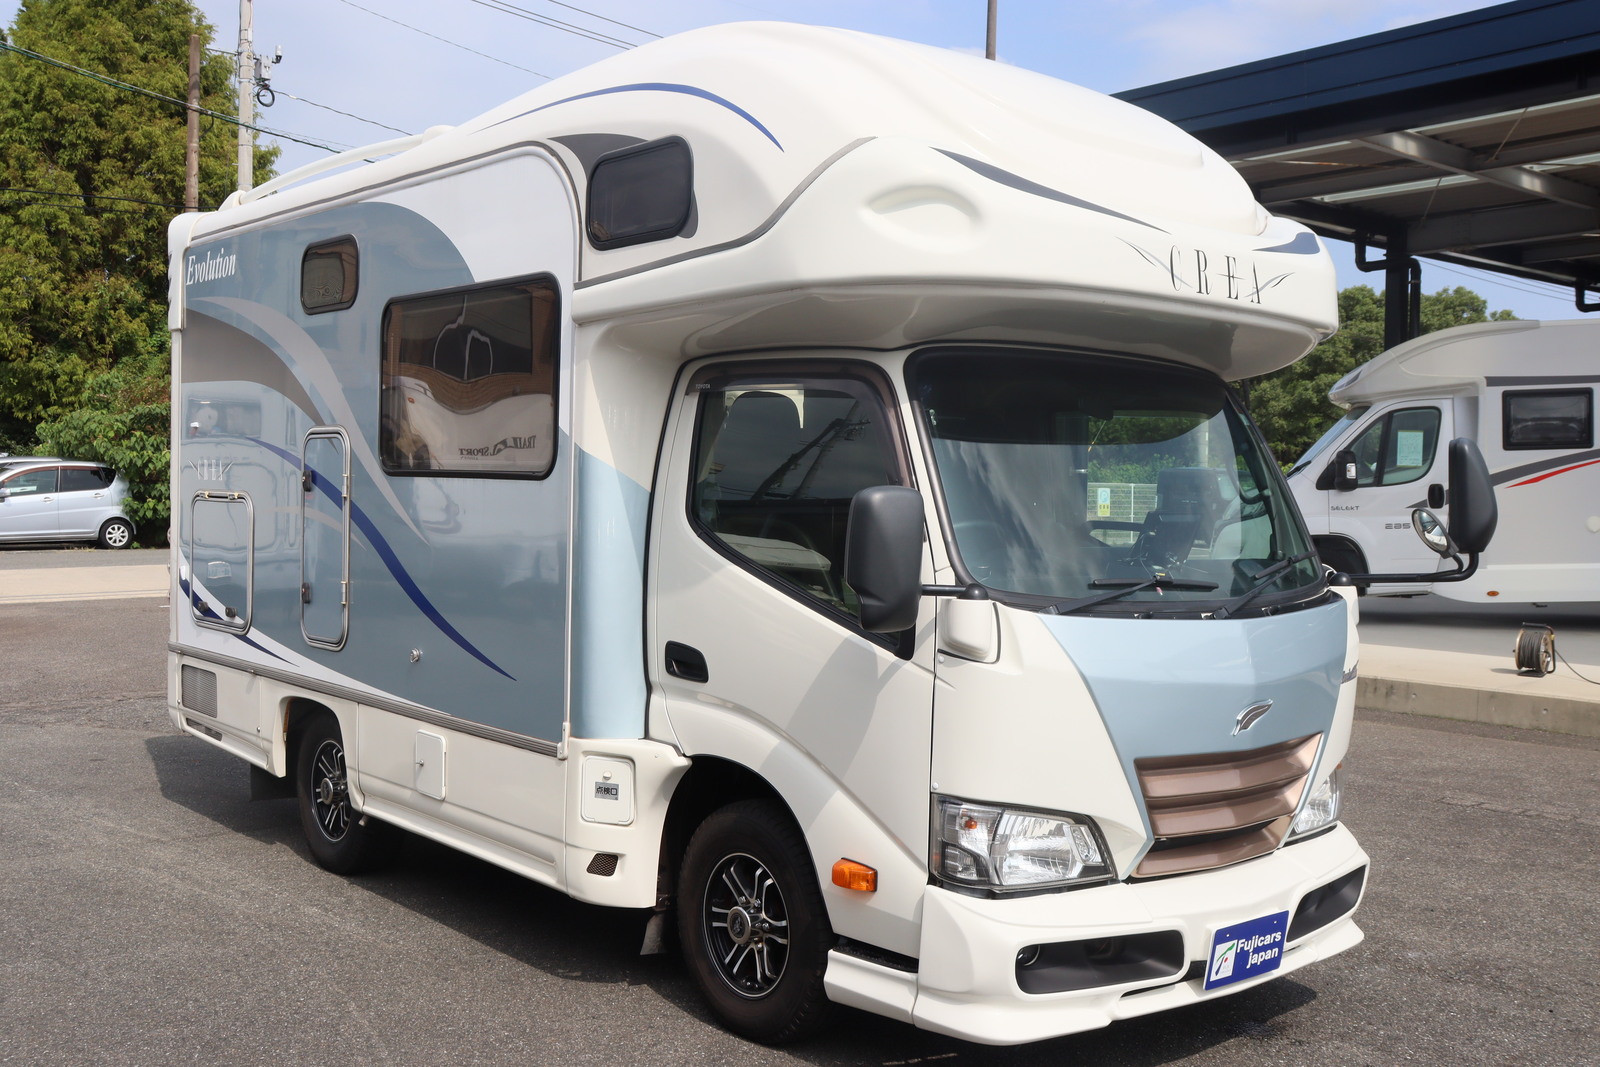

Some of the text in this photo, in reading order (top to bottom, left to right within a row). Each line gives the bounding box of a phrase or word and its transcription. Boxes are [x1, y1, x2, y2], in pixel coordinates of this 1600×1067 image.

[185, 247, 236, 286] Evolution
[1169, 244, 1262, 304] CREA
[595, 785, 618, 796] 点検口
[1236, 931, 1283, 953] Fujicars
[1245, 947, 1280, 969] japan
